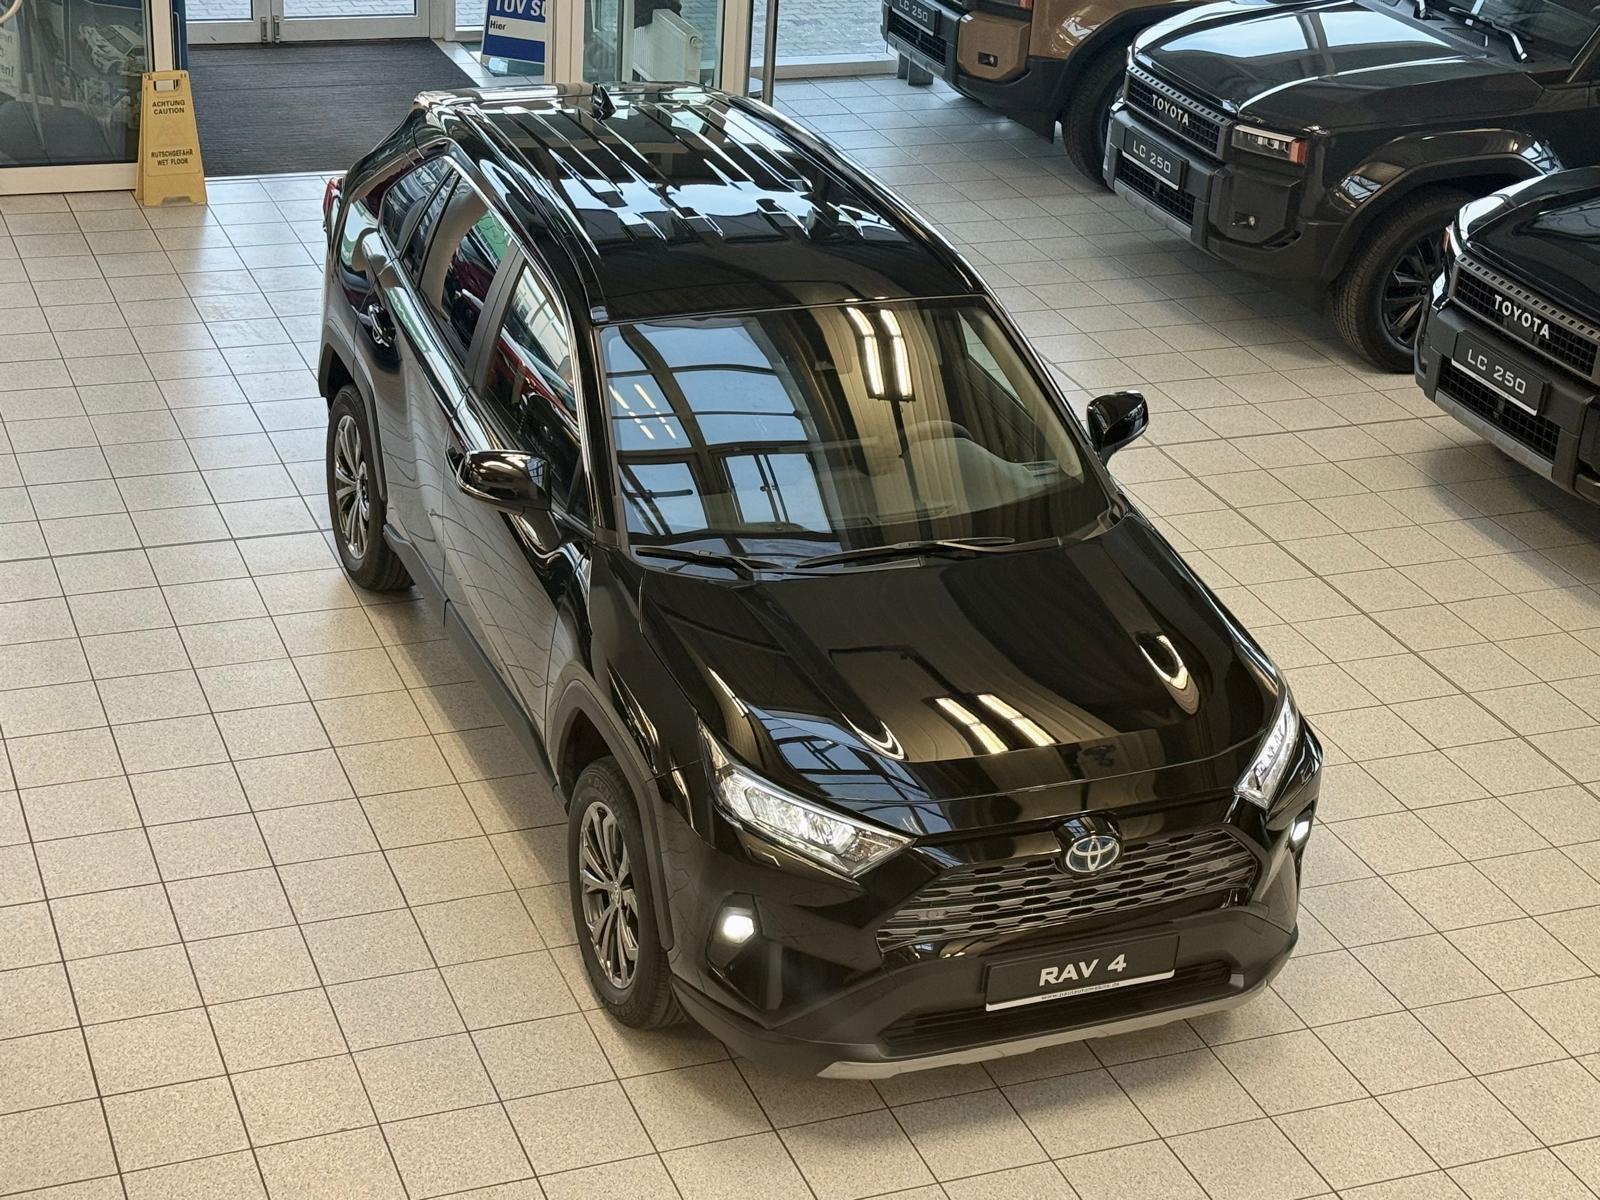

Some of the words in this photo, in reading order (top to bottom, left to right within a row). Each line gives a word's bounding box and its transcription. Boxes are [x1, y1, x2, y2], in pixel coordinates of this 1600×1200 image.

[899, 0, 910, 11] LC
[911, 5, 928, 23] 250
[489, 20, 507, 31] Hier
[152, 99, 186, 108] ACHTUNG
[153, 107, 185, 116] CAUTION
[1152, 94, 1189, 126] TOYOTA
[150, 148, 194, 158] RUTSCHGEFAHR
[157, 158, 169, 167] WET
[170, 157, 189, 166] FLOOR
[1133, 140, 1147, 158] LC
[1149, 152, 1171, 174] 250
[1494, 294, 1550, 340] TOYOTA
[1467, 348, 1488, 371] LC
[1493, 365, 1526, 394] 250
[1038, 958, 1100, 988] RAV
[1107, 953, 1127, 973] 4
